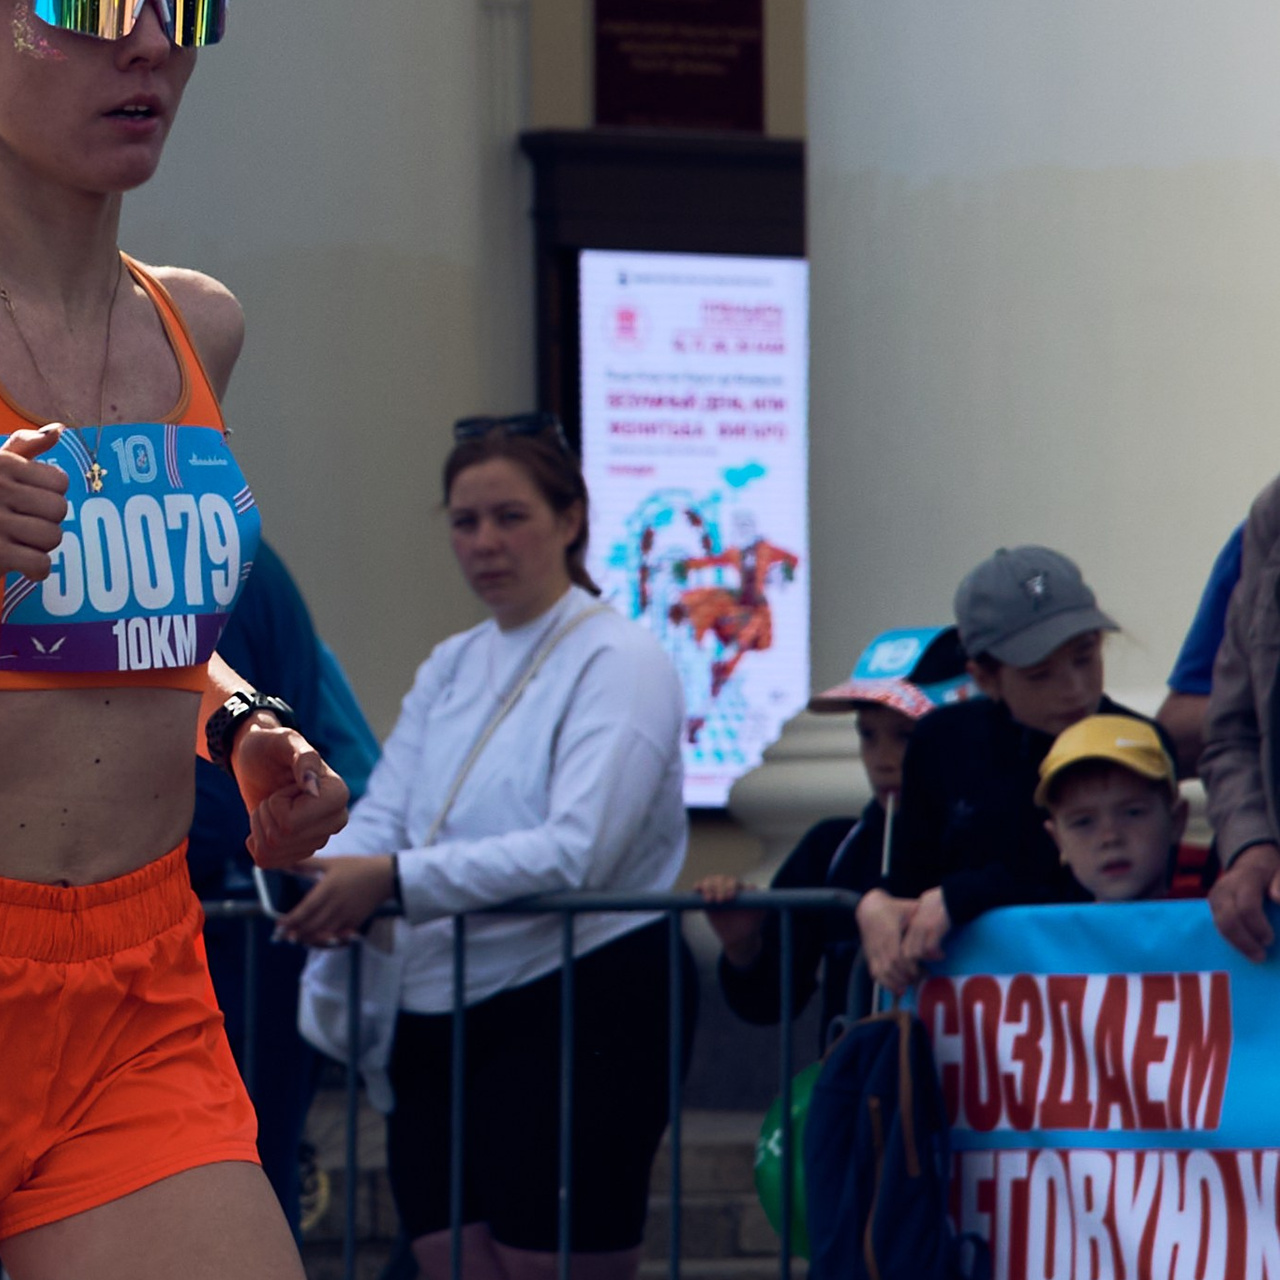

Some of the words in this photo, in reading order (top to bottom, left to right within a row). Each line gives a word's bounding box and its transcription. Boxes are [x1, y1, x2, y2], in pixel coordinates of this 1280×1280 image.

[109, 434, 159, 484] 10
[41, 493, 240, 616] 50079
[112, 612, 198, 672] 10KM
